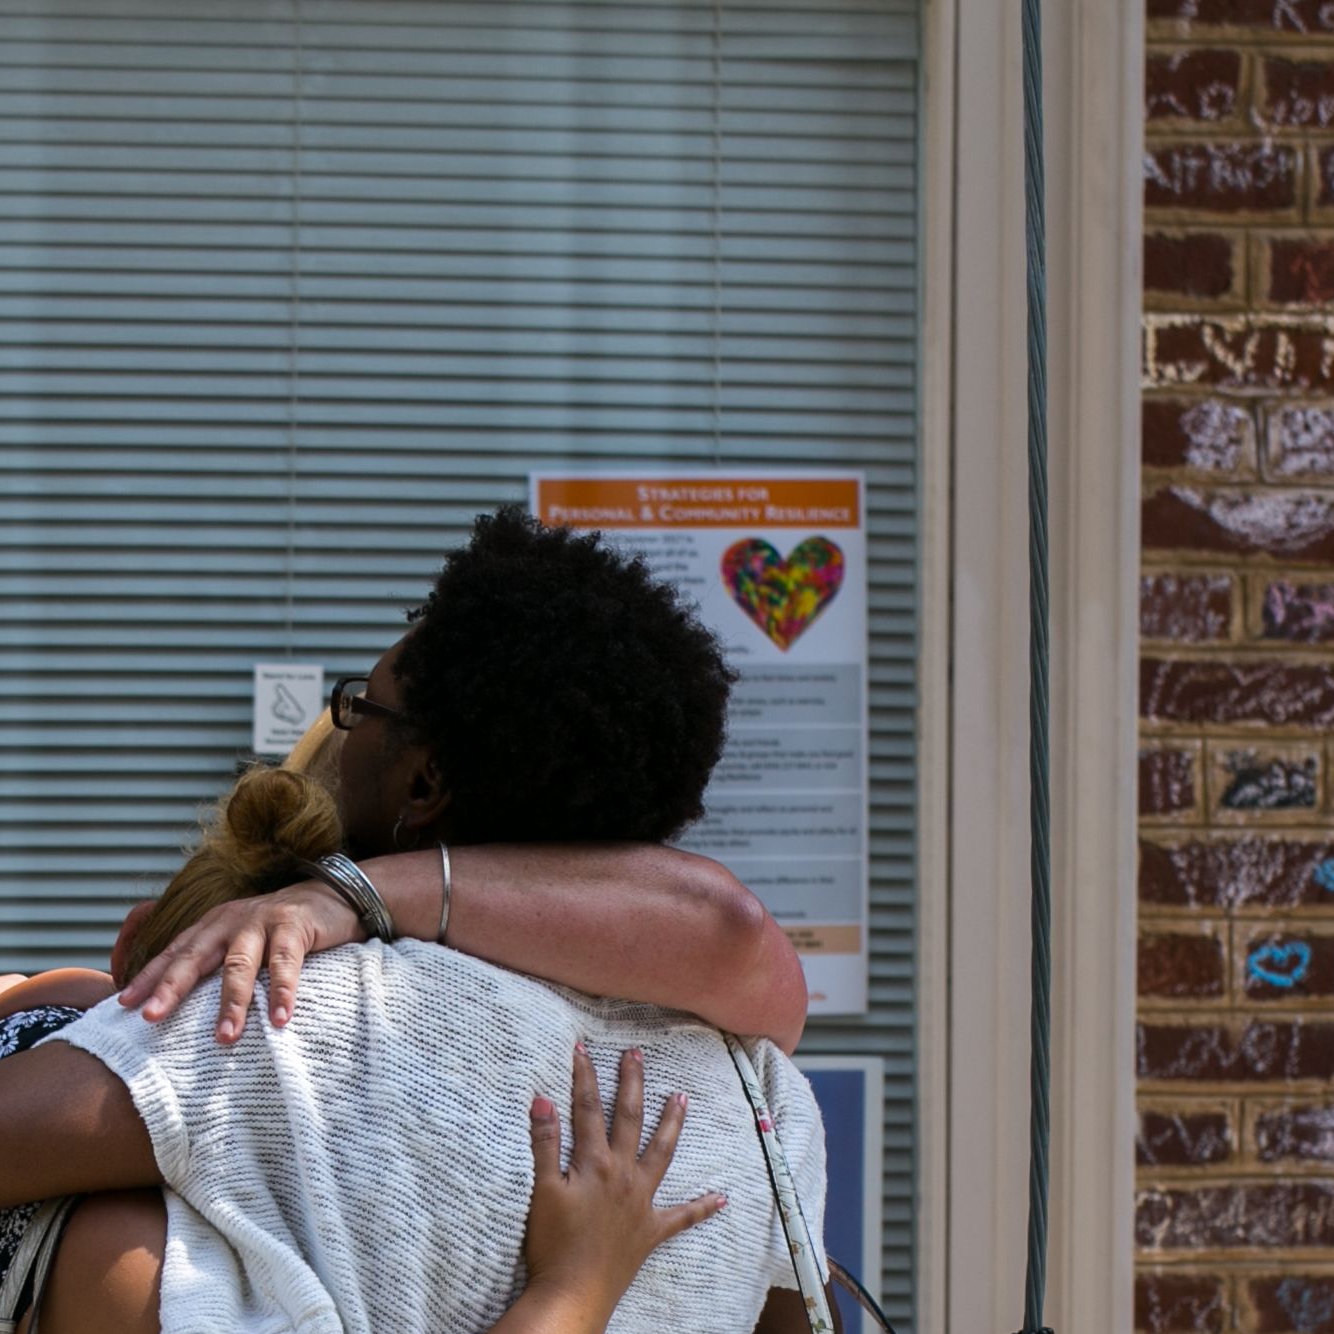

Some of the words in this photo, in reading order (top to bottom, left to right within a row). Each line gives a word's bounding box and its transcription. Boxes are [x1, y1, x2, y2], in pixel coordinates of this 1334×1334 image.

[636, 485, 734, 501] STRATEGIES
[737, 486, 770, 501] FOR
[548, 505, 635, 522] PERSONAL
[639, 506, 654, 521] &
[658, 505, 762, 522] COMMUNITY
[765, 505, 851, 522] RESILIENCE
